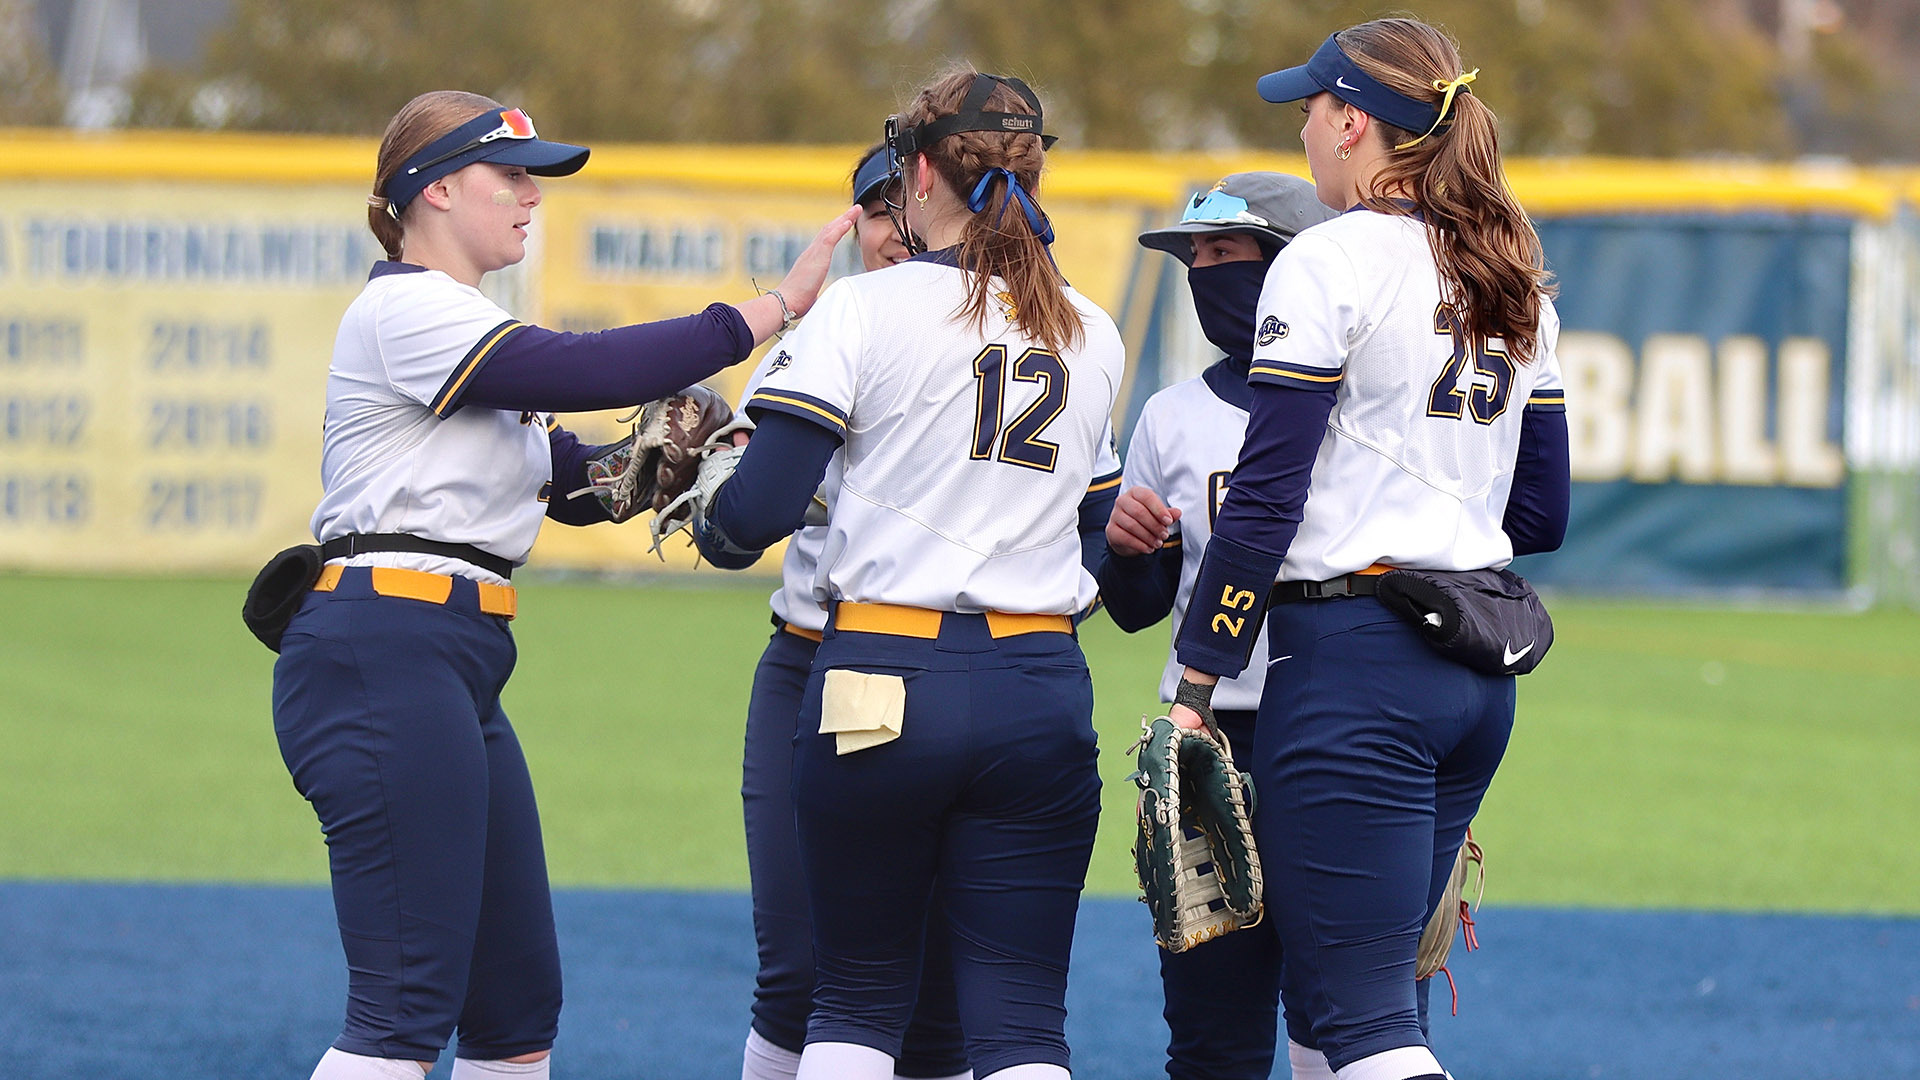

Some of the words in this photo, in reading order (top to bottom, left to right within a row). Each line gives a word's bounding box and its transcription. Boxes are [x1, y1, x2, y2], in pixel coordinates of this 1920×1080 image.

[0, 315, 85, 368] 011
[1426, 300, 1516, 426] 25
[0, 393, 88, 447] 012
[970, 344, 1069, 472] 12
[1557, 329, 1845, 488] BALL
[0, 472, 90, 526] 013
[1212, 584, 1255, 638] 25
